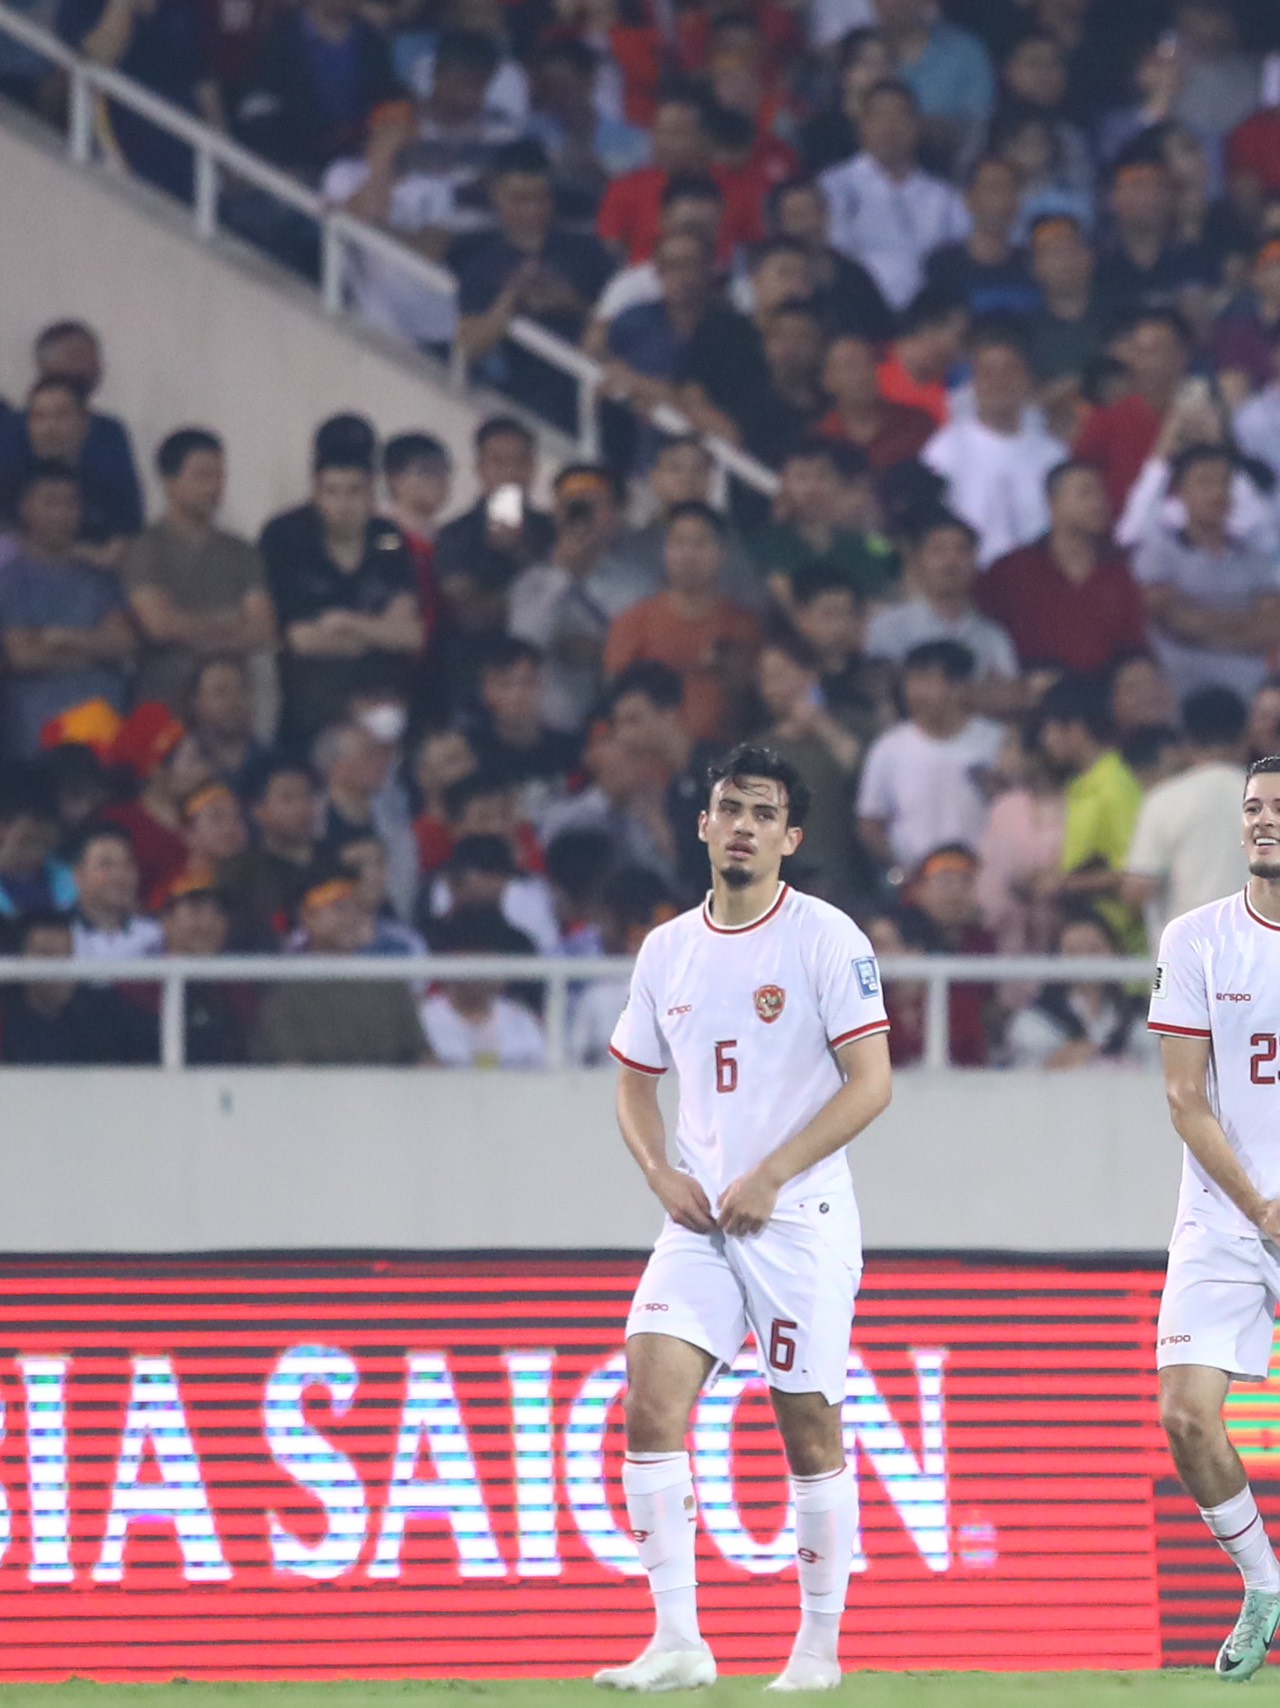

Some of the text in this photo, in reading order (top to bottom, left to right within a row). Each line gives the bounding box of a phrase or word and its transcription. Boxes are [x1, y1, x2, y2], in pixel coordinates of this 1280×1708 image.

[1215, 992, 1252, 1003] erspo
[714, 1039, 737, 1093] 6
[769, 1318, 797, 1372] 6
[0, 1354, 234, 1583] IA
